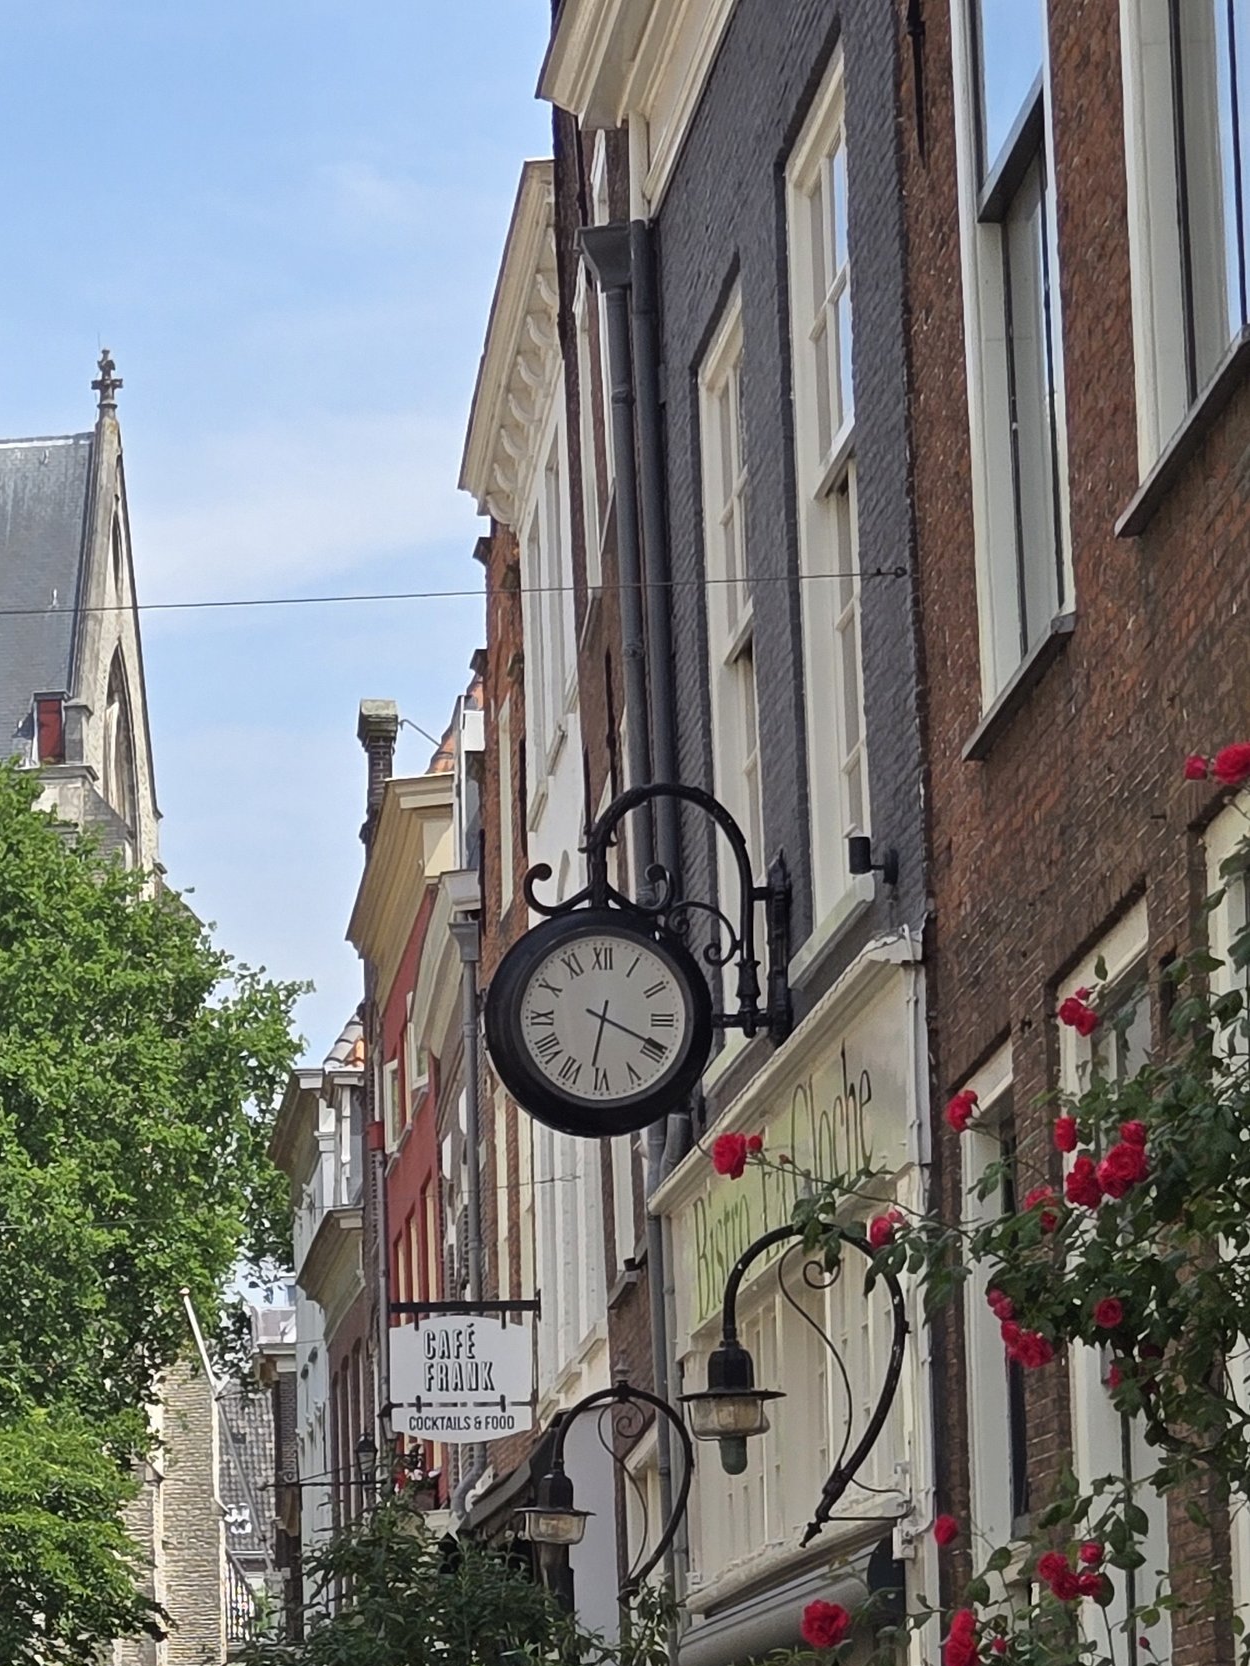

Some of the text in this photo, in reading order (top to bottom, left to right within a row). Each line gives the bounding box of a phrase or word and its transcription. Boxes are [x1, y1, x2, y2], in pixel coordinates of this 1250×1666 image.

[561, 952, 585, 979] XI
[592, 947, 613, 971] XII
[538, 979, 563, 998] X
[643, 980, 667, 999] II
[530, 1010, 554, 1027] IX
[651, 1013, 674, 1027] III
[534, 1032, 564, 1065] VIII
[558, 1056, 581, 1086] VII
[594, 1067, 610, 1092] VI
[626, 1062, 642, 1086] V
[693, 1190, 751, 1324] Bistro
[790, 1038, 873, 1202] Cloche
[423, 1322, 476, 1360] CAFÉ
[423, 1361, 496, 1392] FRANK
[409, 1415, 515, 1431] COCKTAILS & FOOD
